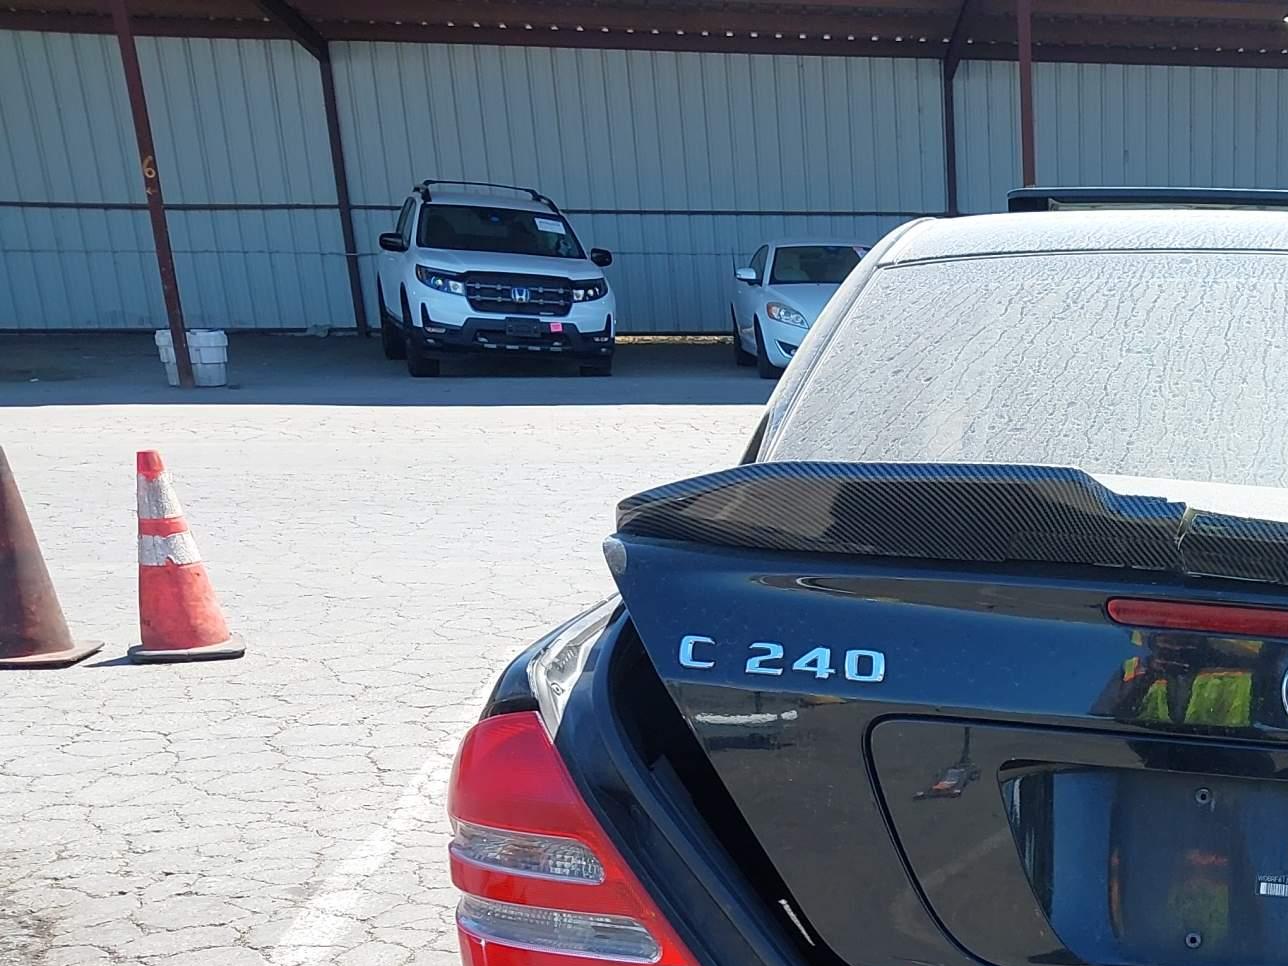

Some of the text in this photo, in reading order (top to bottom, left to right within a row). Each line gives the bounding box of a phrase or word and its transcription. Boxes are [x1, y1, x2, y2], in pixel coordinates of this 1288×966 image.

[143, 155, 156, 178] 6
[679, 635, 886, 683] C 240
